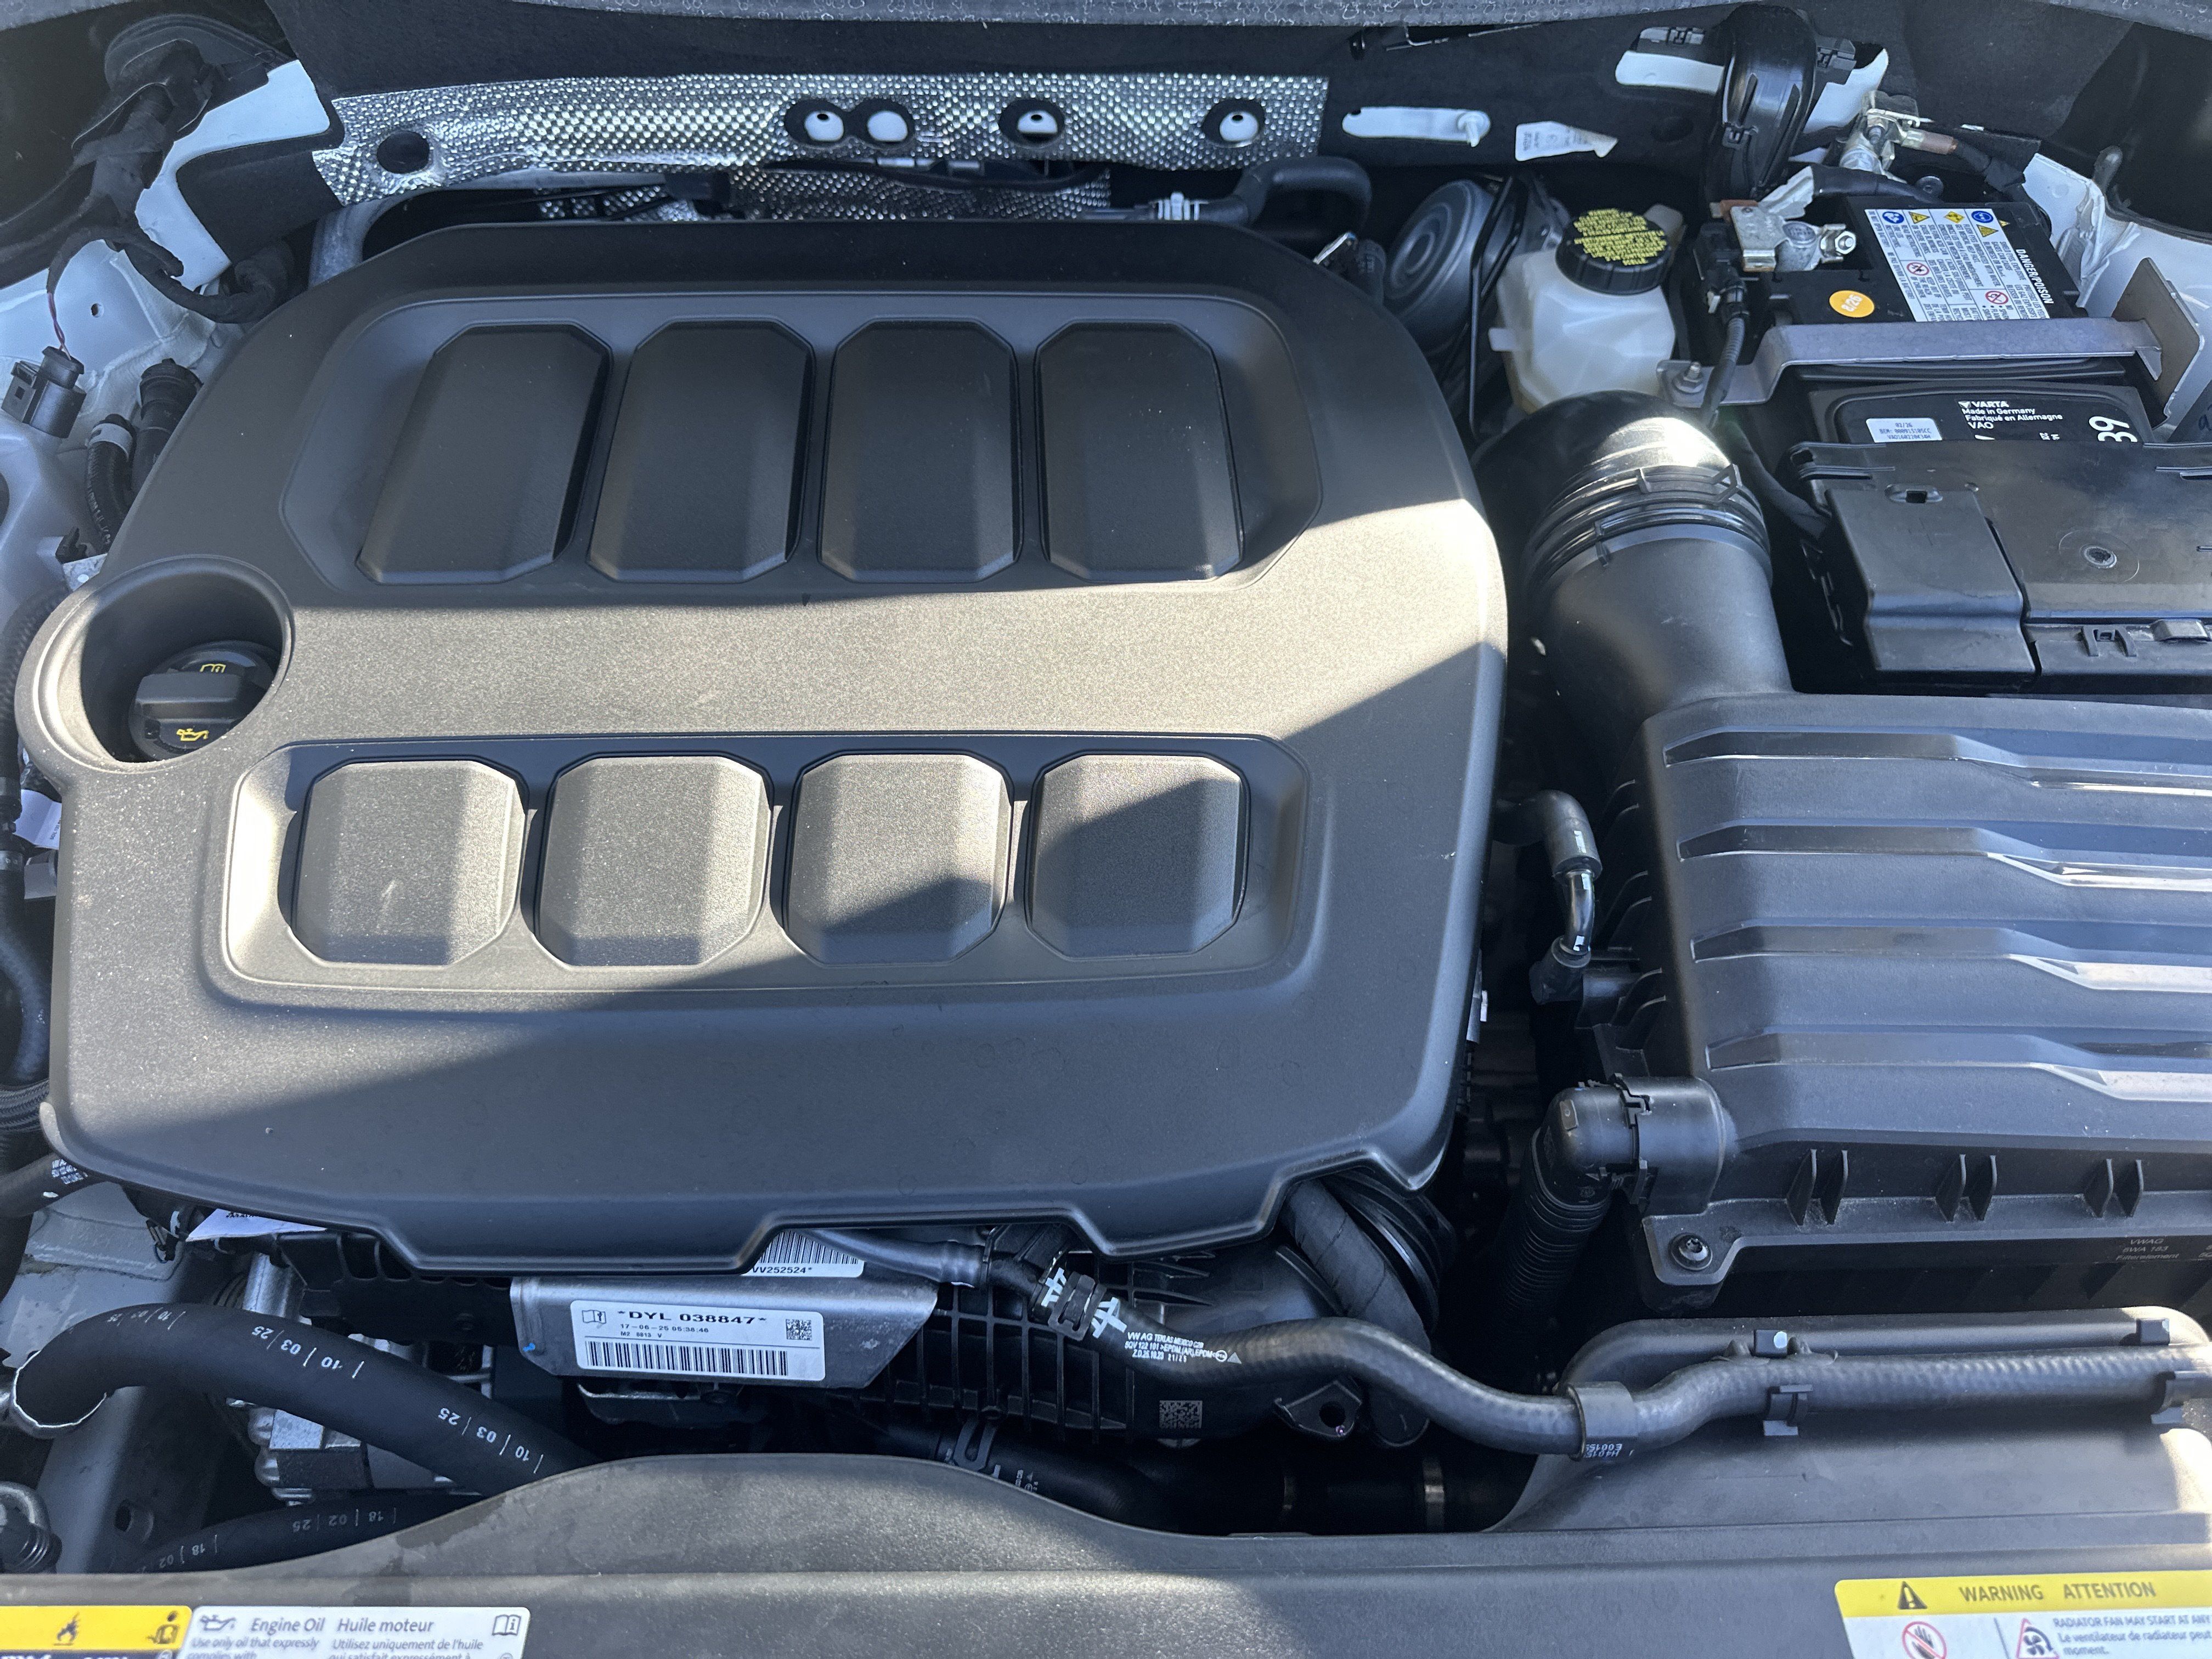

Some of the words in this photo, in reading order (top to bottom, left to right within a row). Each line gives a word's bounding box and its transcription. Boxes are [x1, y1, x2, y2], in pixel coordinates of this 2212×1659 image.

[2016, 249, 2054, 303] DANGER/POISON
[252, 1325, 274, 1340] 25
[280, 1339, 301, 1356] 03
[321, 1356, 342, 1370] 10
[438, 1407, 461, 1426] 25
[476, 1426, 497, 1443] 03
[515, 1445, 530, 1462] 10
[1959, 1584, 2044, 1601] WARNING
[2063, 1582, 2156, 1599] ATTENTION
[251, 1618, 301, 1635] Engine
[304, 1618, 326, 1631] Oil
[337, 1618, 376, 1632] Huile
[379, 1618, 435, 1632] moteur
[2053, 1617, 2102, 1627] RADIATOR
[2103, 1617, 2124, 1626] FAN
[2126, 1616, 2146, 1625] MAY
[2147, 1615, 2176, 1625] START
[2179, 1615, 2189, 1624] AT
[192, 1638, 211, 1648] Use
[212, 1637, 232, 1650] only
[235, 1637, 247, 1647] oil
[251, 1637, 270, 1647] that
[273, 1637, 320, 1650] expressly
[332, 1639, 370, 1650] Utilisez
[373, 1639, 435, 1651] uniquement
[437, 1639, 450, 1649] de
[453, 1639, 483, 1650] l'huile
[2058, 1633, 2071, 1643] Le
[2073, 1632, 2125, 1641] ventilateur
[2129, 1630, 2141, 1640] de
[2143, 1630, 2186, 1640] radiateur
